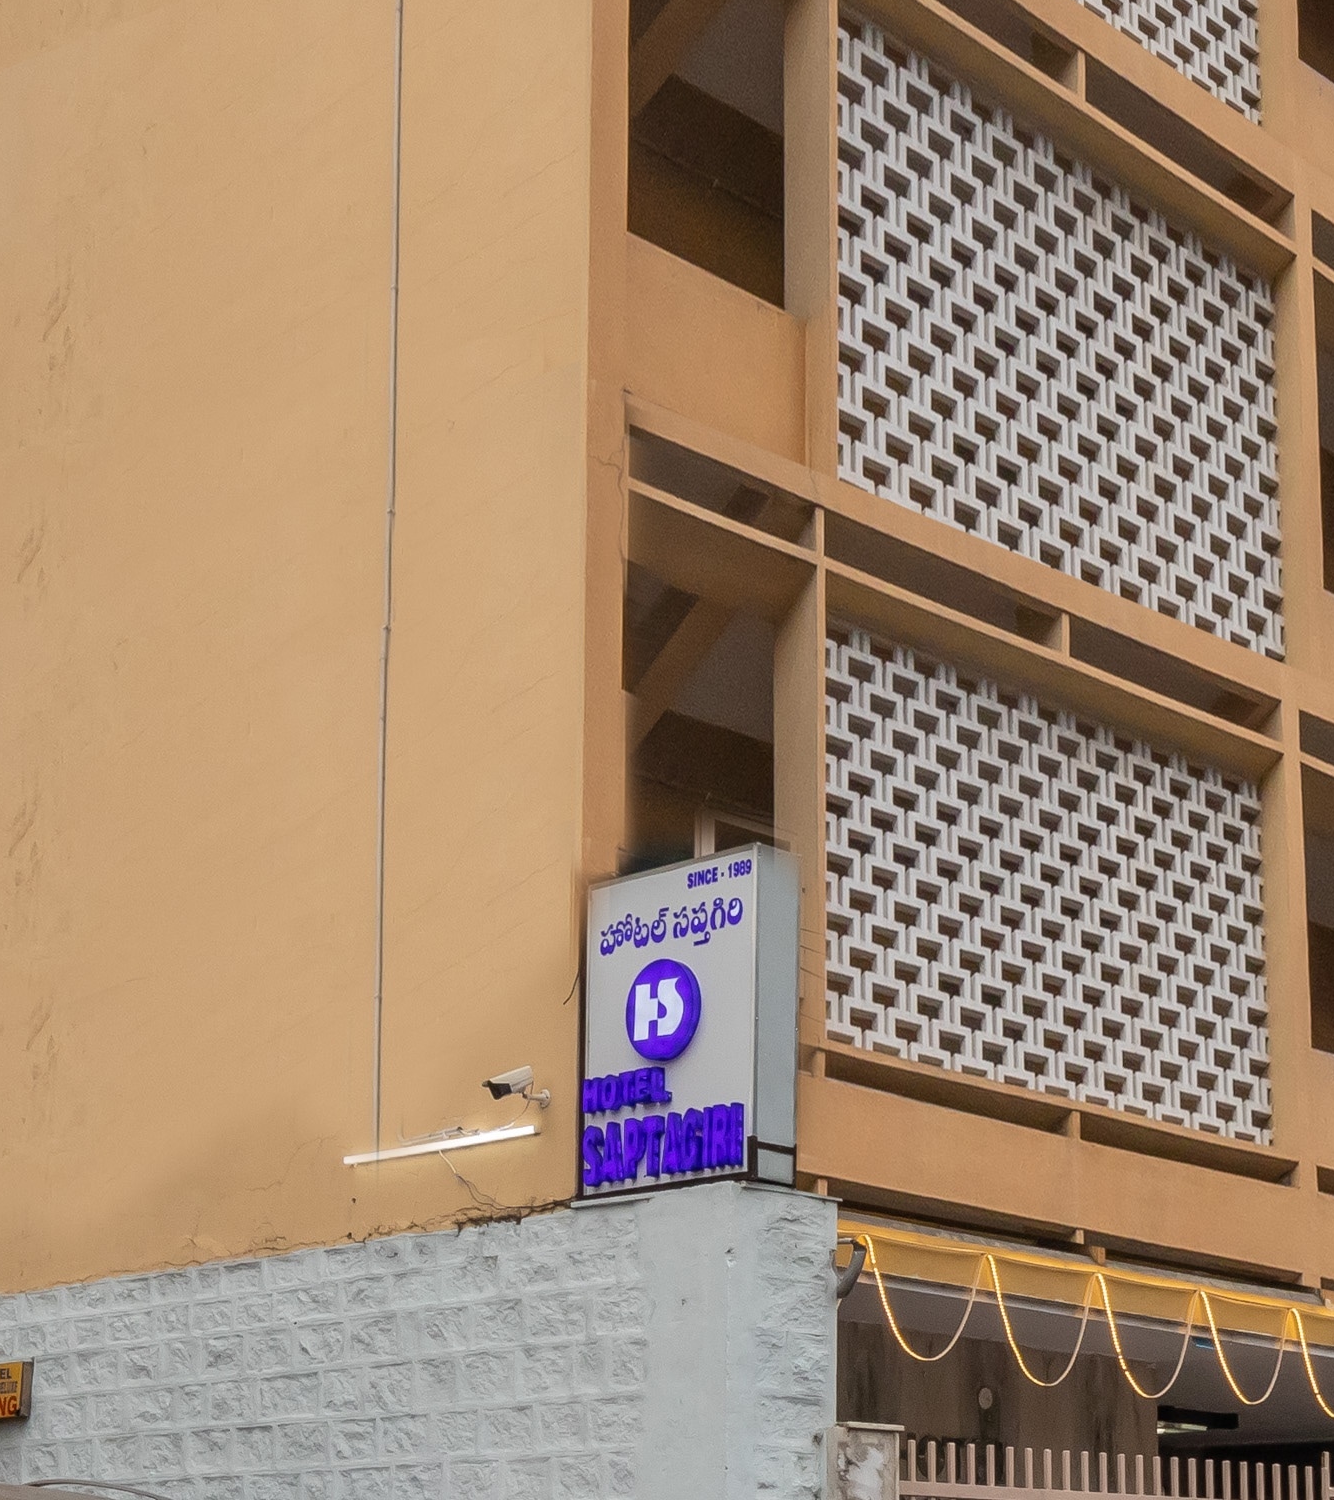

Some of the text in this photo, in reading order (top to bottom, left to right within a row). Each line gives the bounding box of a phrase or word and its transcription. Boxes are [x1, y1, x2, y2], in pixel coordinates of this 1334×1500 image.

[687, 866, 718, 889] SINCE
[728, 859, 752, 878] 1989
[600, 897, 743, 956] హోటల్ సప్తగిరి
[583, 1066, 672, 1113] HOTEL
[583, 1102, 744, 1187] SAPTAGIRI
